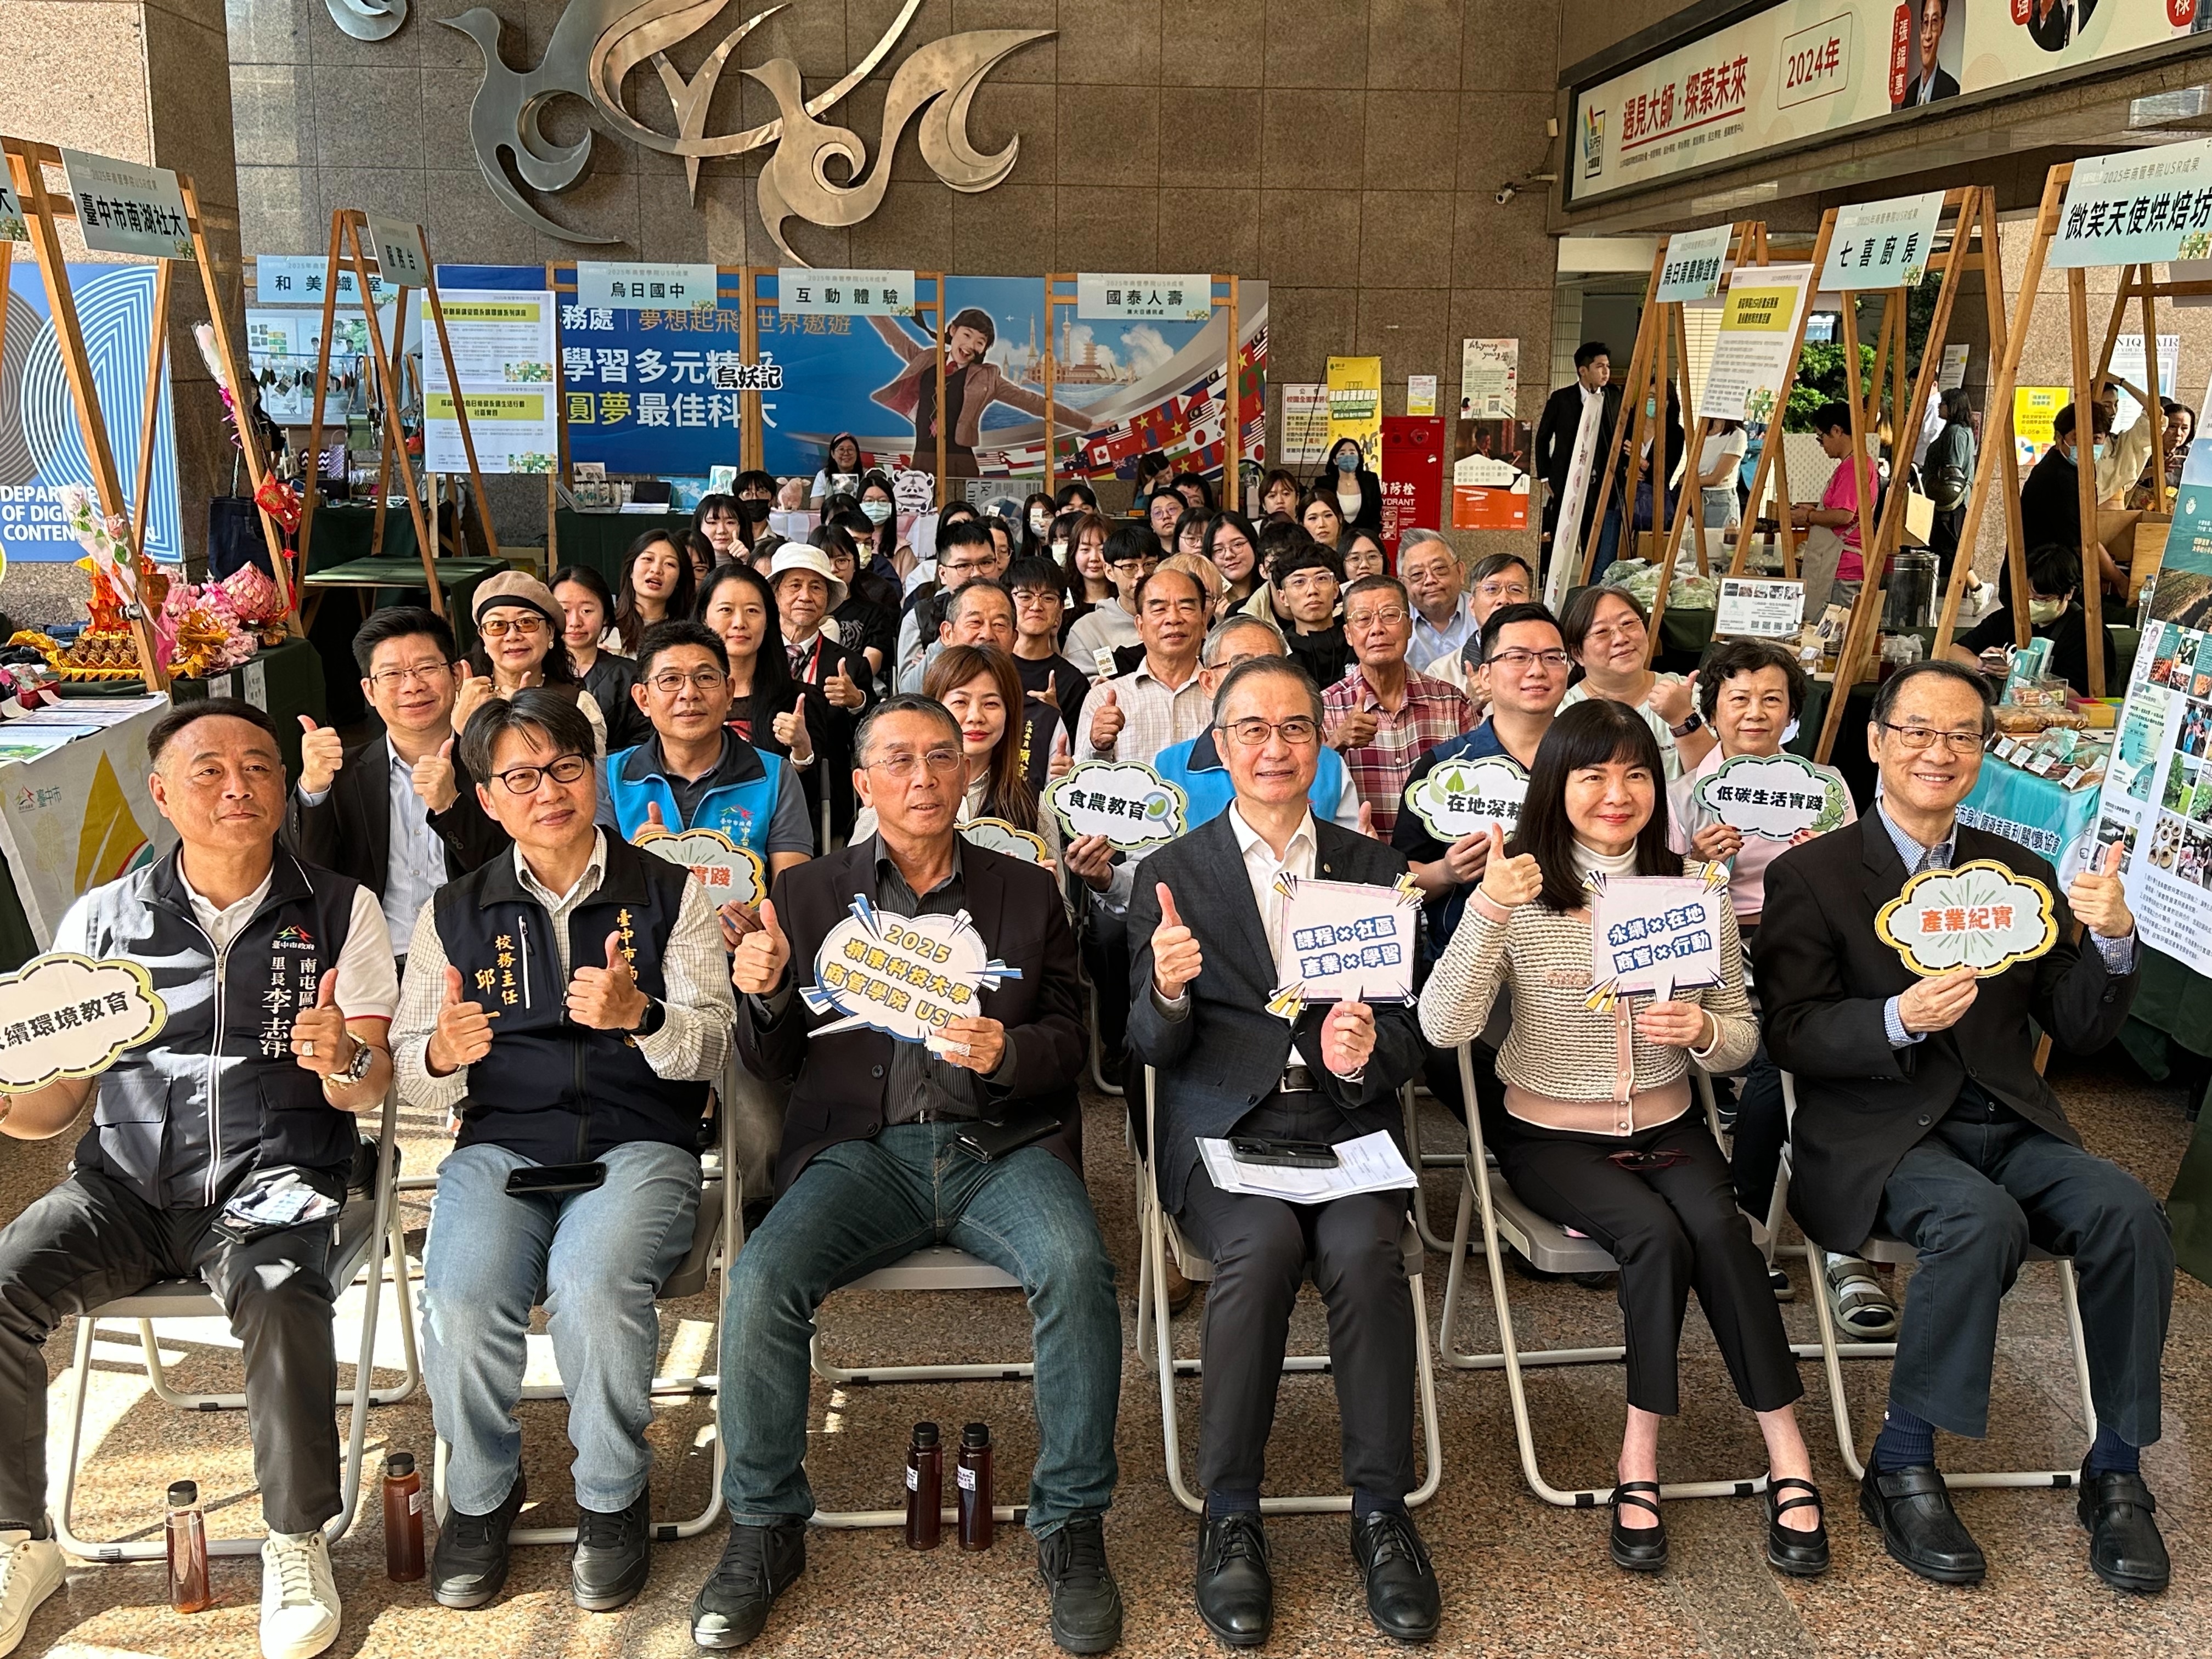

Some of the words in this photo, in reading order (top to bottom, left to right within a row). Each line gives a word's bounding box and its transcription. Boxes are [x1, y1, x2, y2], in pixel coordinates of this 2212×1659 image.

[1786, 36, 1840, 88] 2024年
[80, 192, 185, 237] 臺中市南湖社大
[2065, 187, 2212, 240] 微笑天使烘焙坊
[1839, 232, 1919, 267] 七喜廚房
[275, 275, 382, 292] 和美織室
[611, 282, 685, 299] 烏日國中
[795, 288, 898, 304] 互動體驗
[1106, 290, 1183, 306] 國泰人壽
[758, 308, 852, 335] 世界遨遊
[715, 365, 781, 389] 烏妖記
[2, 505, 25, 521] OF
[1069, 790, 1147, 821] 食農教育
[1717, 786, 1823, 812] 低碳生活實踐
[1921, 906, 2013, 933] 產業紀實
[272, 940, 315, 950] 臺中市政府
[883, 924, 952, 963] 2025
[495, 934, 518, 1006] 校務主任
[843, 938, 973, 1005] 嶺東科技大學
[823, 961, 911, 1013] 商管學院
